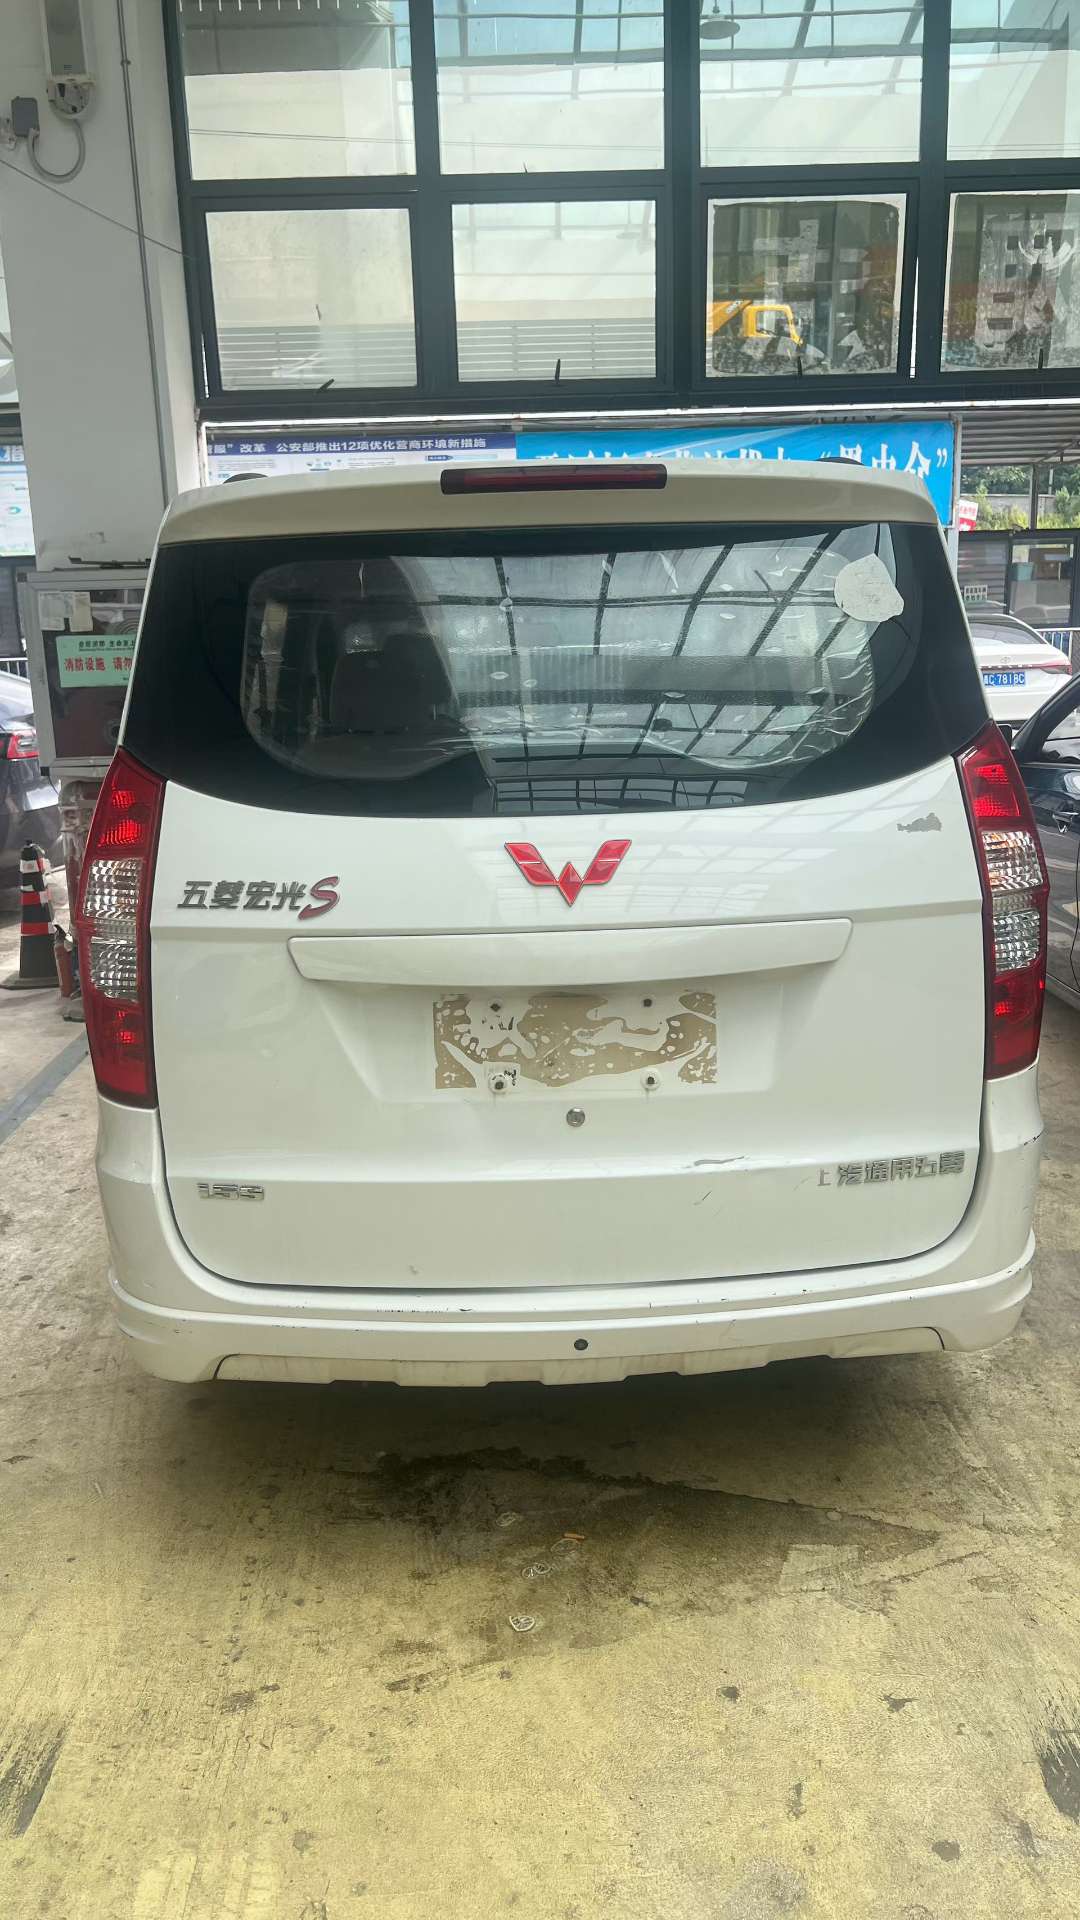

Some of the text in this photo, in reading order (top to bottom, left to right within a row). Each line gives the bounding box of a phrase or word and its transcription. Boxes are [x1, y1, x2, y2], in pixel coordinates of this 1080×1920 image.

[276, 437, 487, 453] 公安部推出12项优化营商环境新措施
[64, 656, 106, 672] 消防设施
[177, 875, 340, 920] 五菱宏光S
